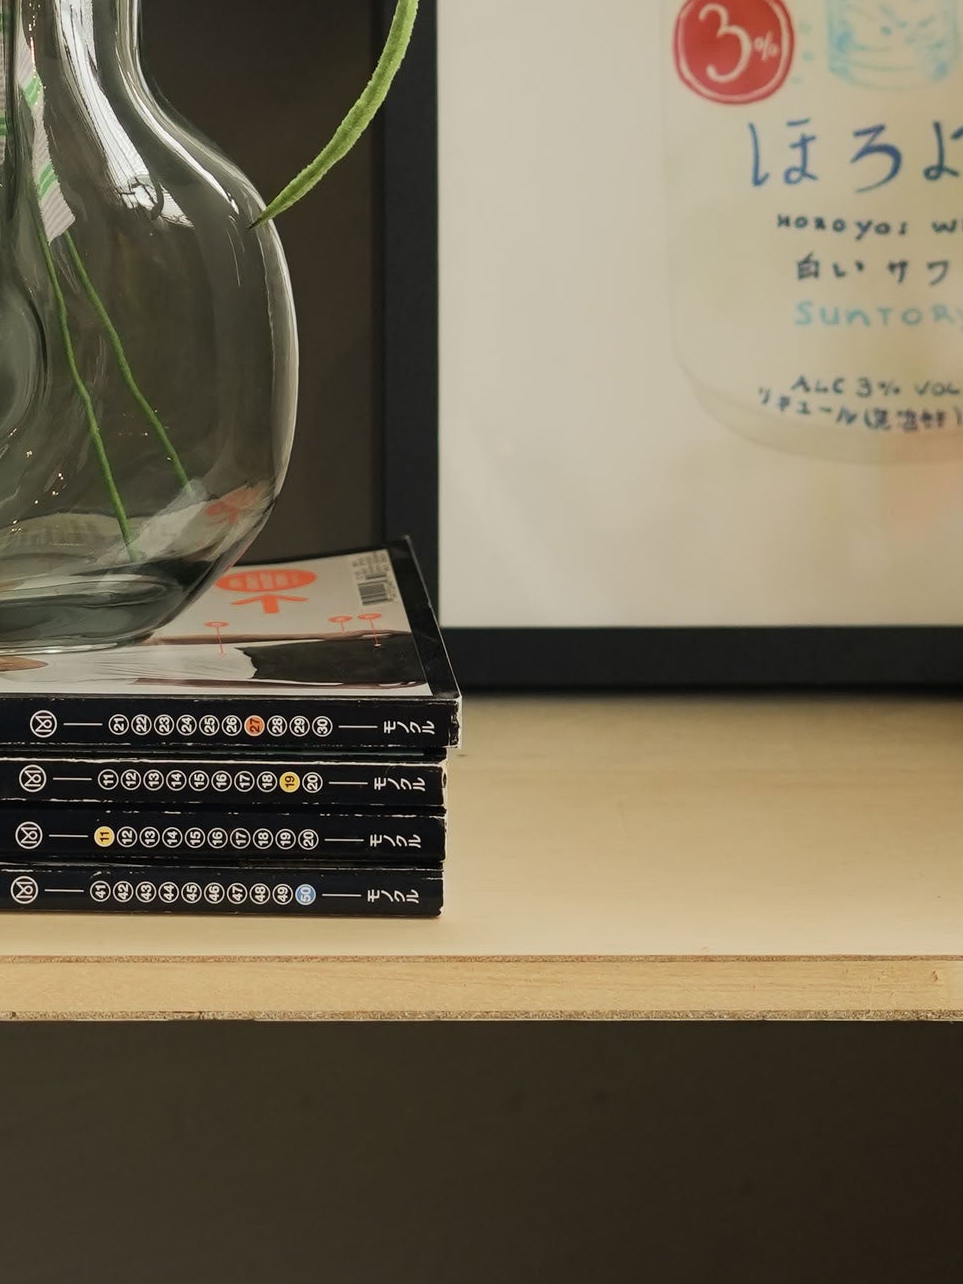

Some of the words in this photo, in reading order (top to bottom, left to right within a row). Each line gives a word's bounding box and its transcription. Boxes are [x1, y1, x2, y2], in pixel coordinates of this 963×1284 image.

[698, 2, 778, 83] 3%
[383, 720, 436, 735] モノクル
[374, 776, 426, 791] モノクル
[369, 833, 422, 848] モノクル
[367, 889, 420, 903] モノクル
